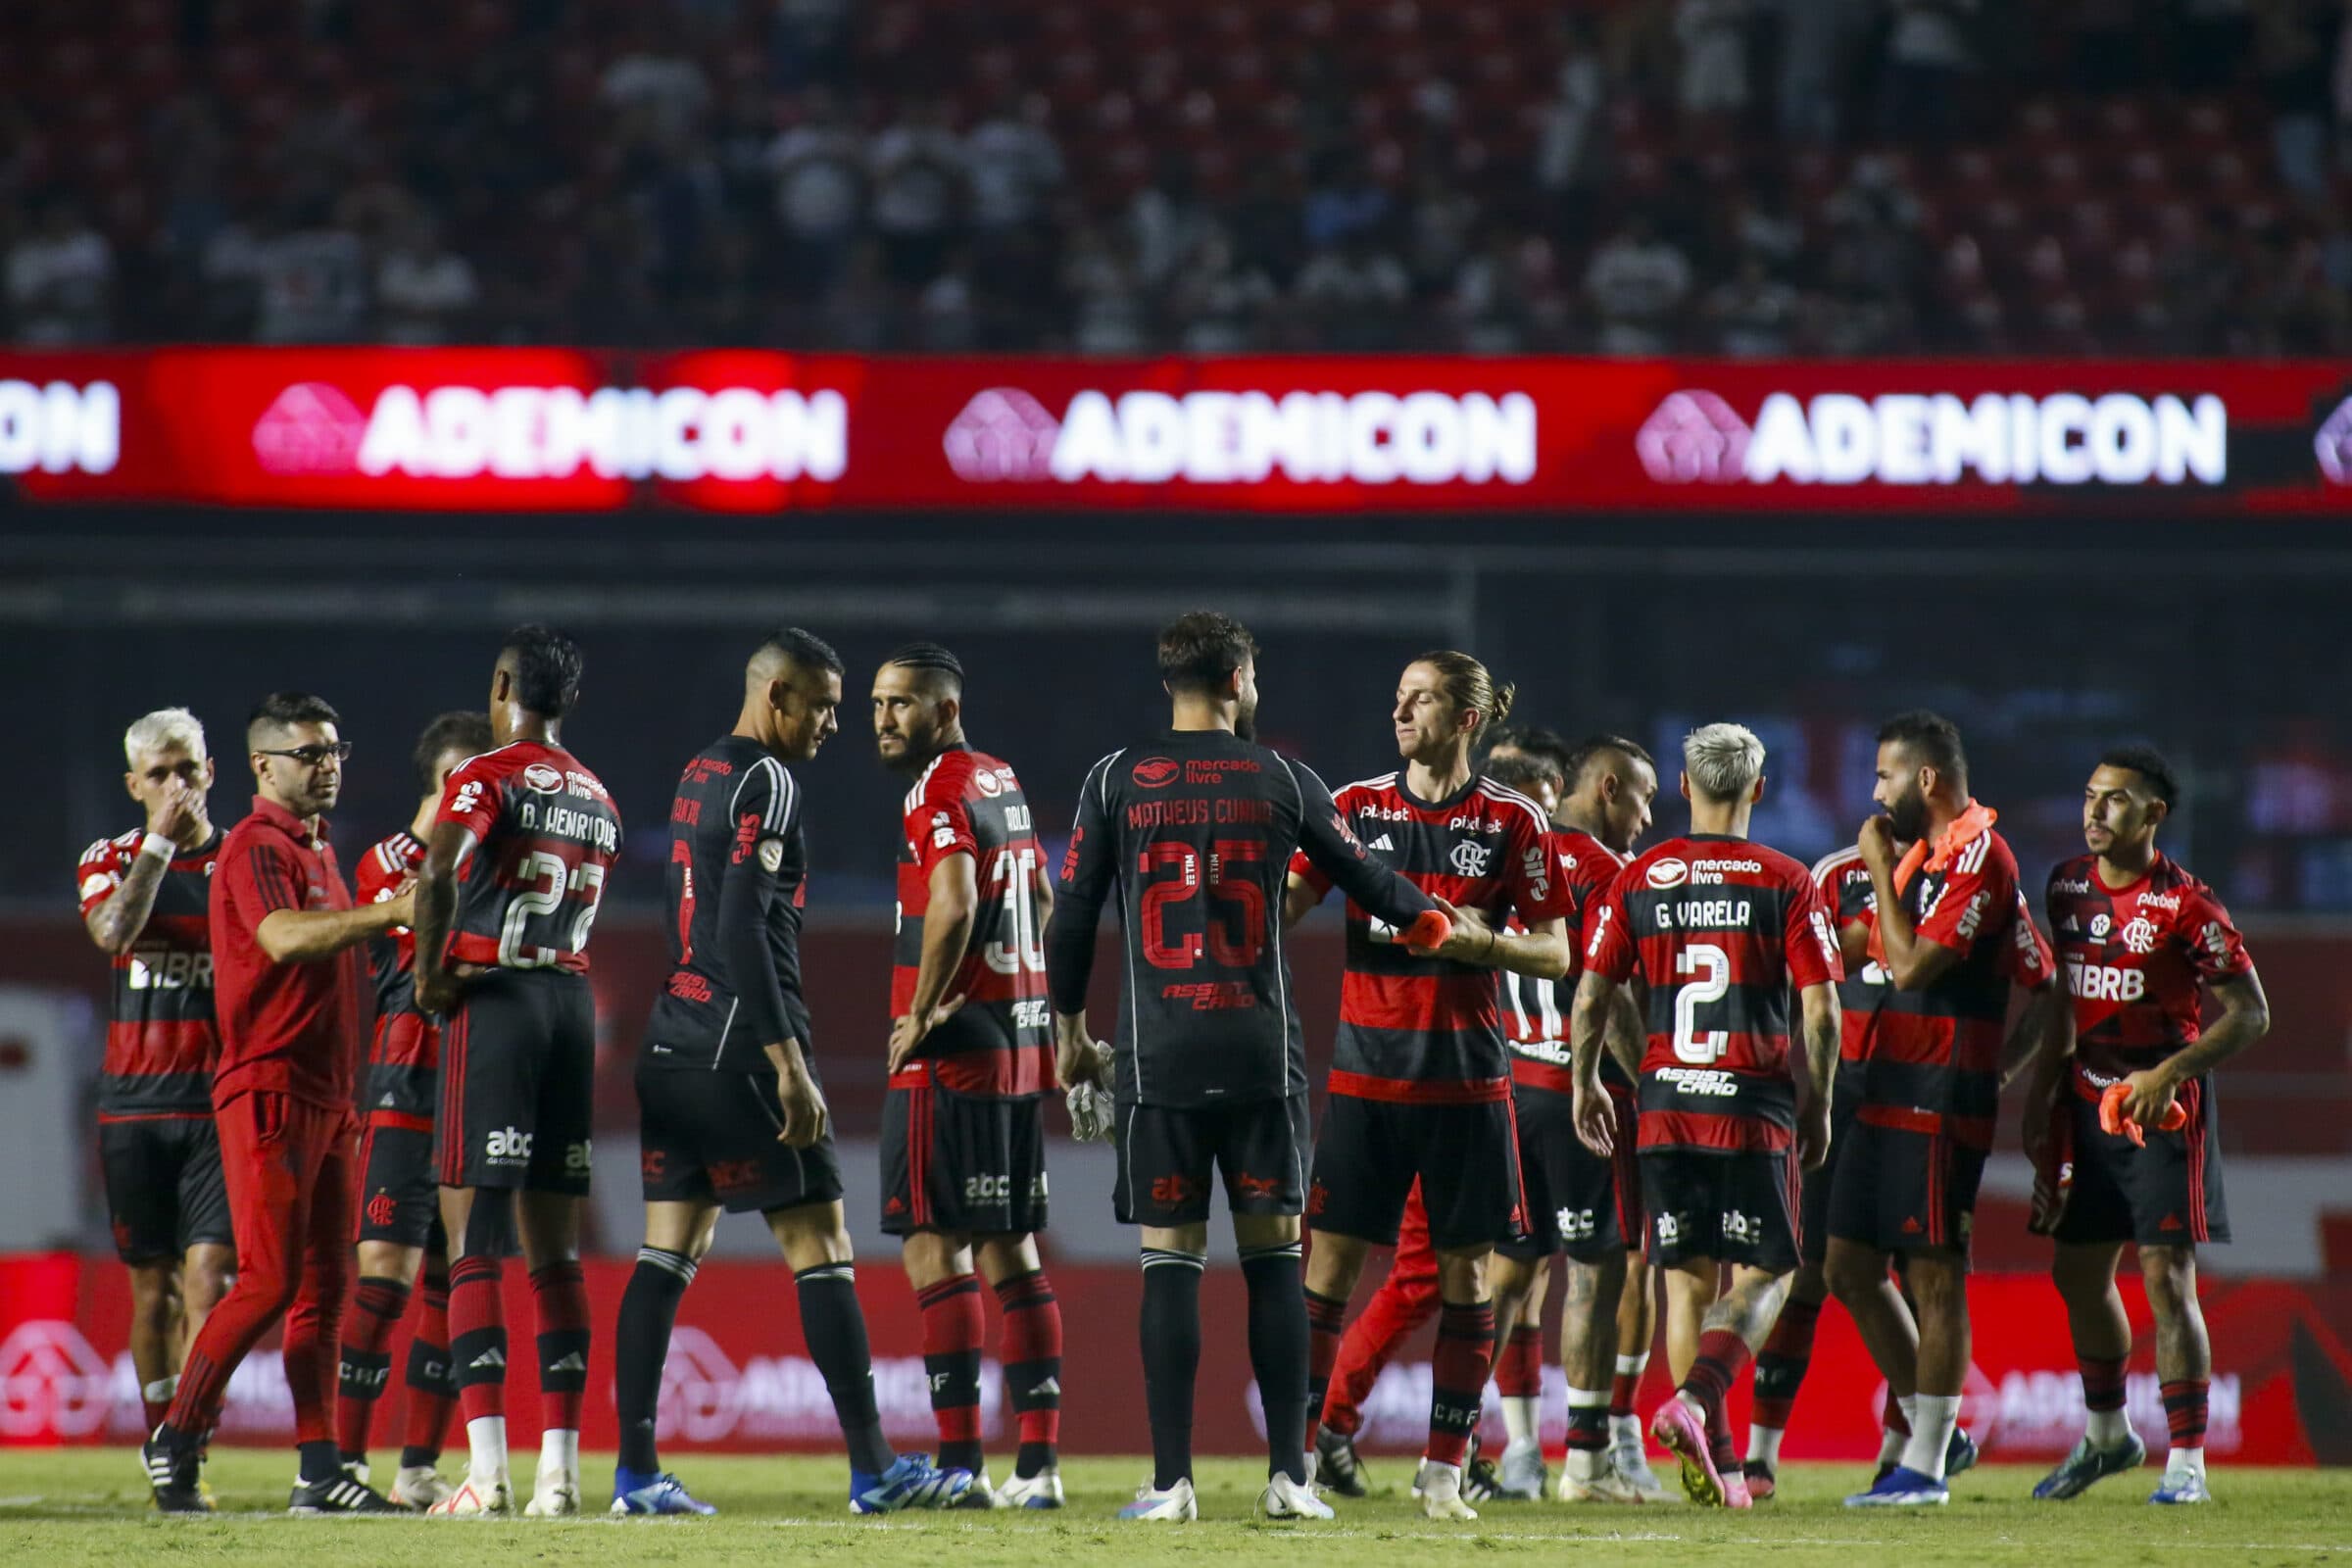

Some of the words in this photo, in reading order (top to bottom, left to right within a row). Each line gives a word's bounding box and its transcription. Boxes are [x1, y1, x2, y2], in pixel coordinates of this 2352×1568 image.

[357, 383, 848, 481] ADEMICON
[1050, 389, 1537, 484] ADEMICON
[1742, 391, 2227, 484] ADEMICON
[1186, 759, 1261, 773] mercado
[1186, 770, 1222, 784] livre
[1128, 799, 1208, 830] MATHEUS
[1359, 804, 1409, 821] pibet
[545, 806, 617, 853] HENRIQUE
[1690, 870, 1724, 886] livre
[1691, 858, 1762, 873] mercado
[984, 848, 1047, 974] 30
[1139, 840, 1267, 969] 25
[1655, 903, 1672, 928] G.
[1677, 900, 1751, 928] VARELA
[2136, 891, 2181, 910] pixbet
[161, 953, 214, 989] BR
[2082, 964, 2144, 1002] BRB
[1674, 944, 1730, 1064] 2
[1655, 1066, 1735, 1084] ASSIST
[1677, 1080, 1739, 1097] CARD
[486, 1126, 533, 1157] abc
